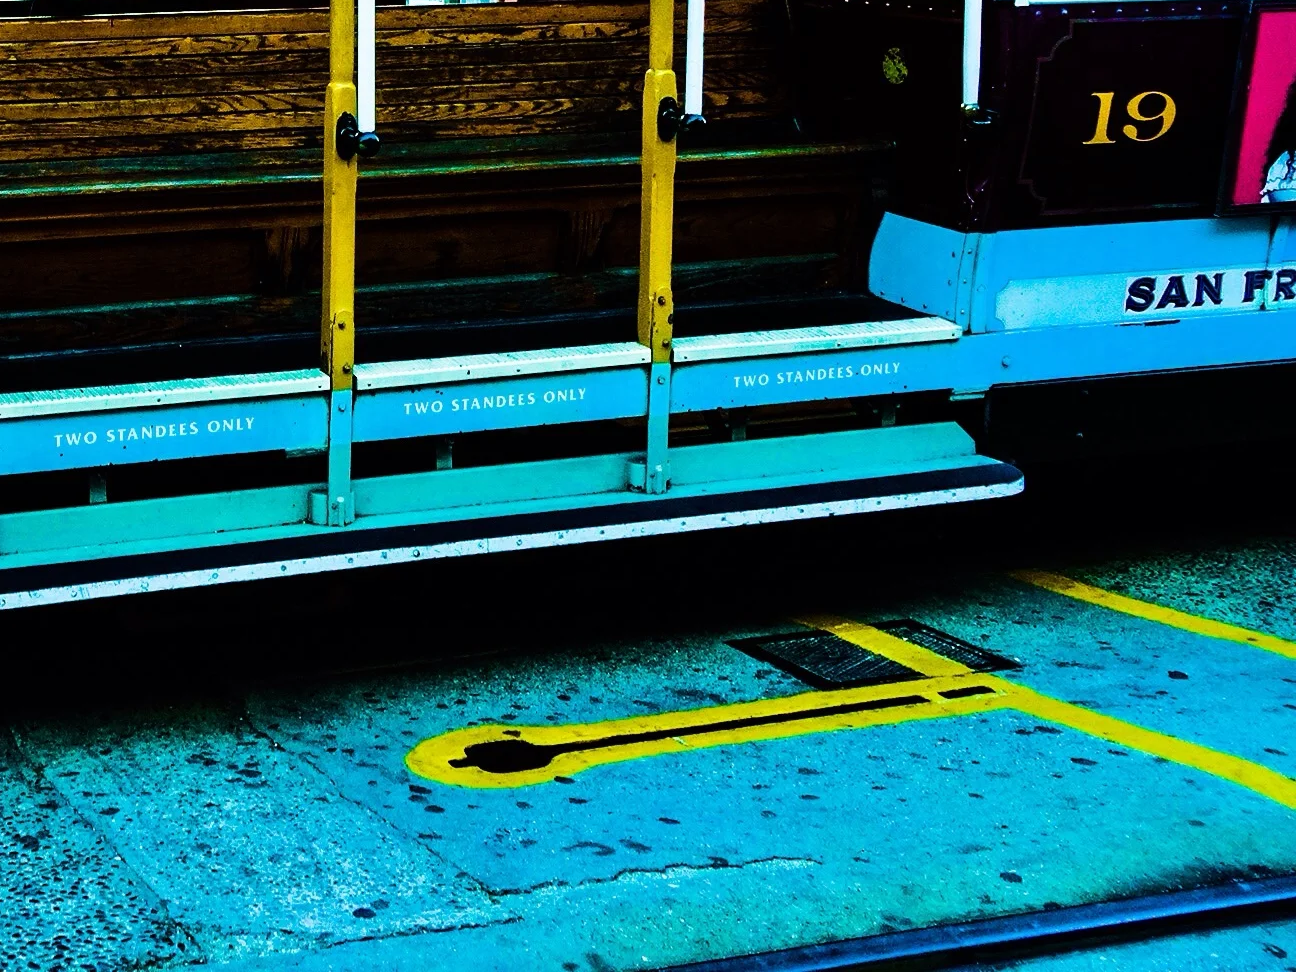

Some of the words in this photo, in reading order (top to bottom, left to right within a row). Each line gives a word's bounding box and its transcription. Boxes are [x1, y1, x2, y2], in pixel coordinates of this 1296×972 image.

[1082, 90, 1177, 145] 19
[1124, 271, 1226, 313] SAN
[733, 373, 770, 388] TWO
[776, 365, 854, 385] STANDEES
[860, 362, 901, 377] ONLY
[403, 400, 444, 415] TWO
[451, 392, 536, 412] STANDEES
[543, 387, 587, 404] ONLY
[54, 431, 98, 448] TWO
[106, 421, 199, 443] STANDEES
[207, 417, 255, 433] ONLY
